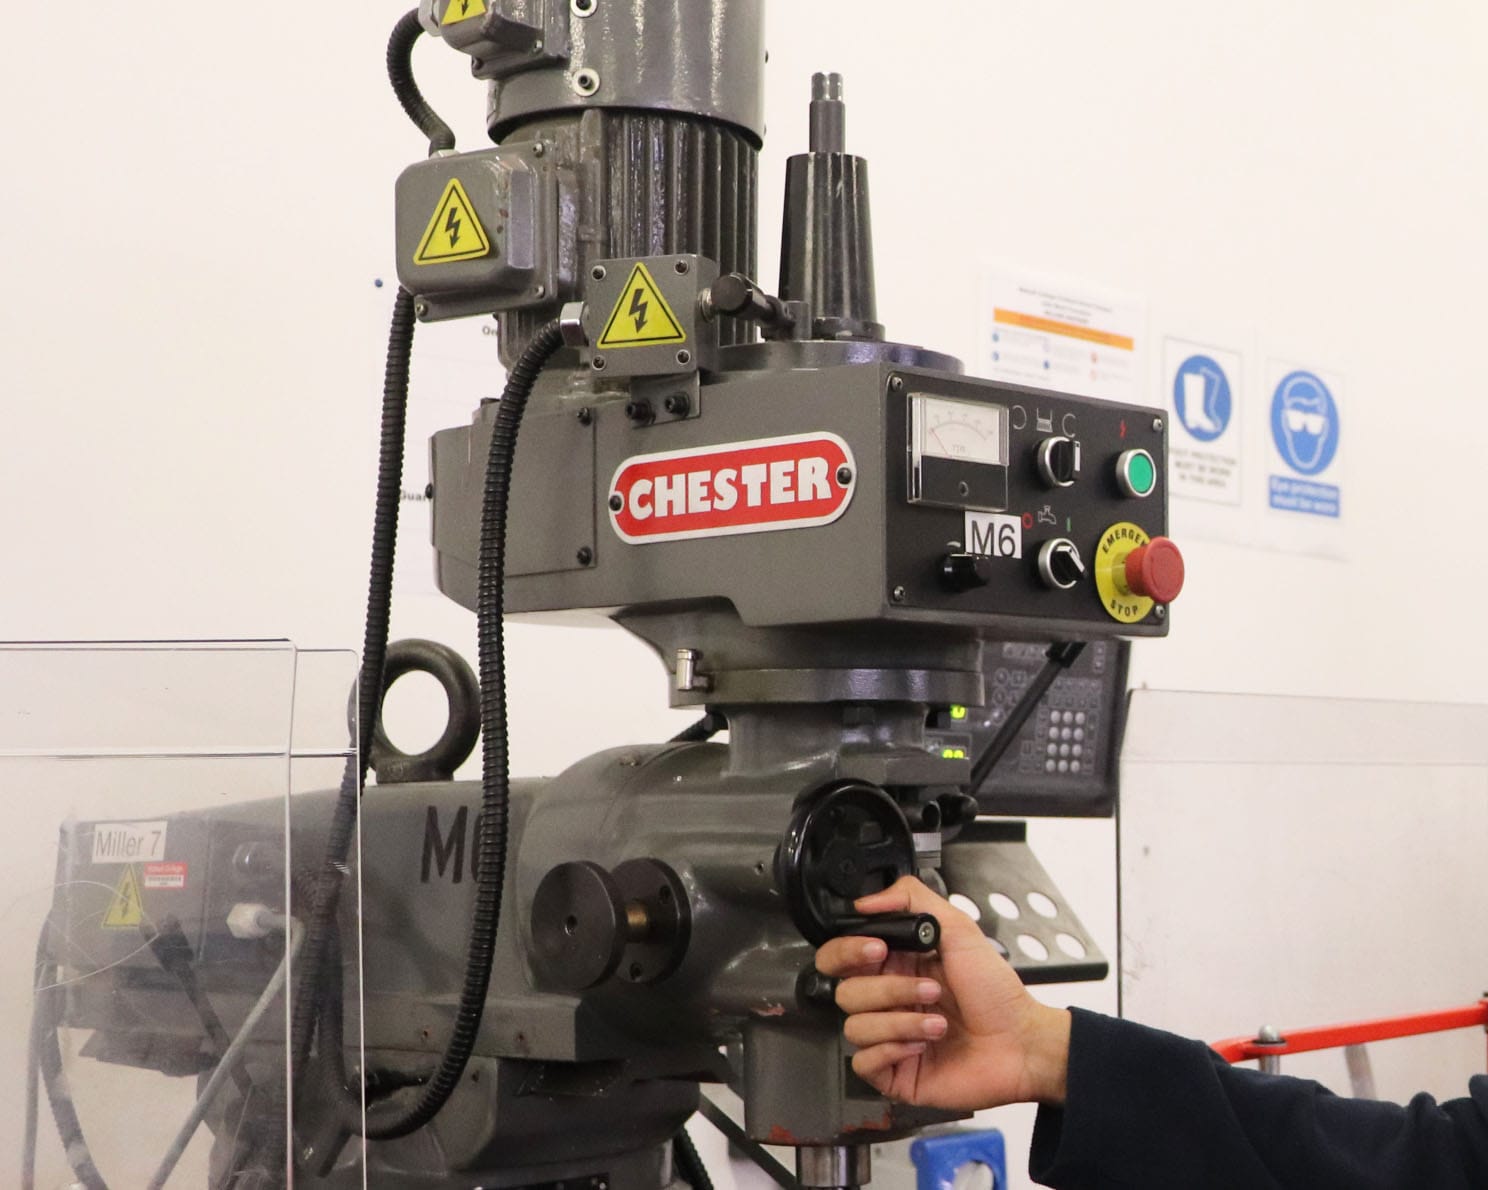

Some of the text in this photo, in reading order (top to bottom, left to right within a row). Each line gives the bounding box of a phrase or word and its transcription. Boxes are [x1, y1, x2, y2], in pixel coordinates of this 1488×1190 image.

[628, 456, 833, 520] CHESTER
[971, 520, 1016, 558] M6
[1110, 599, 1138, 617] STOP
[95, 830, 162, 857] Miller 7
